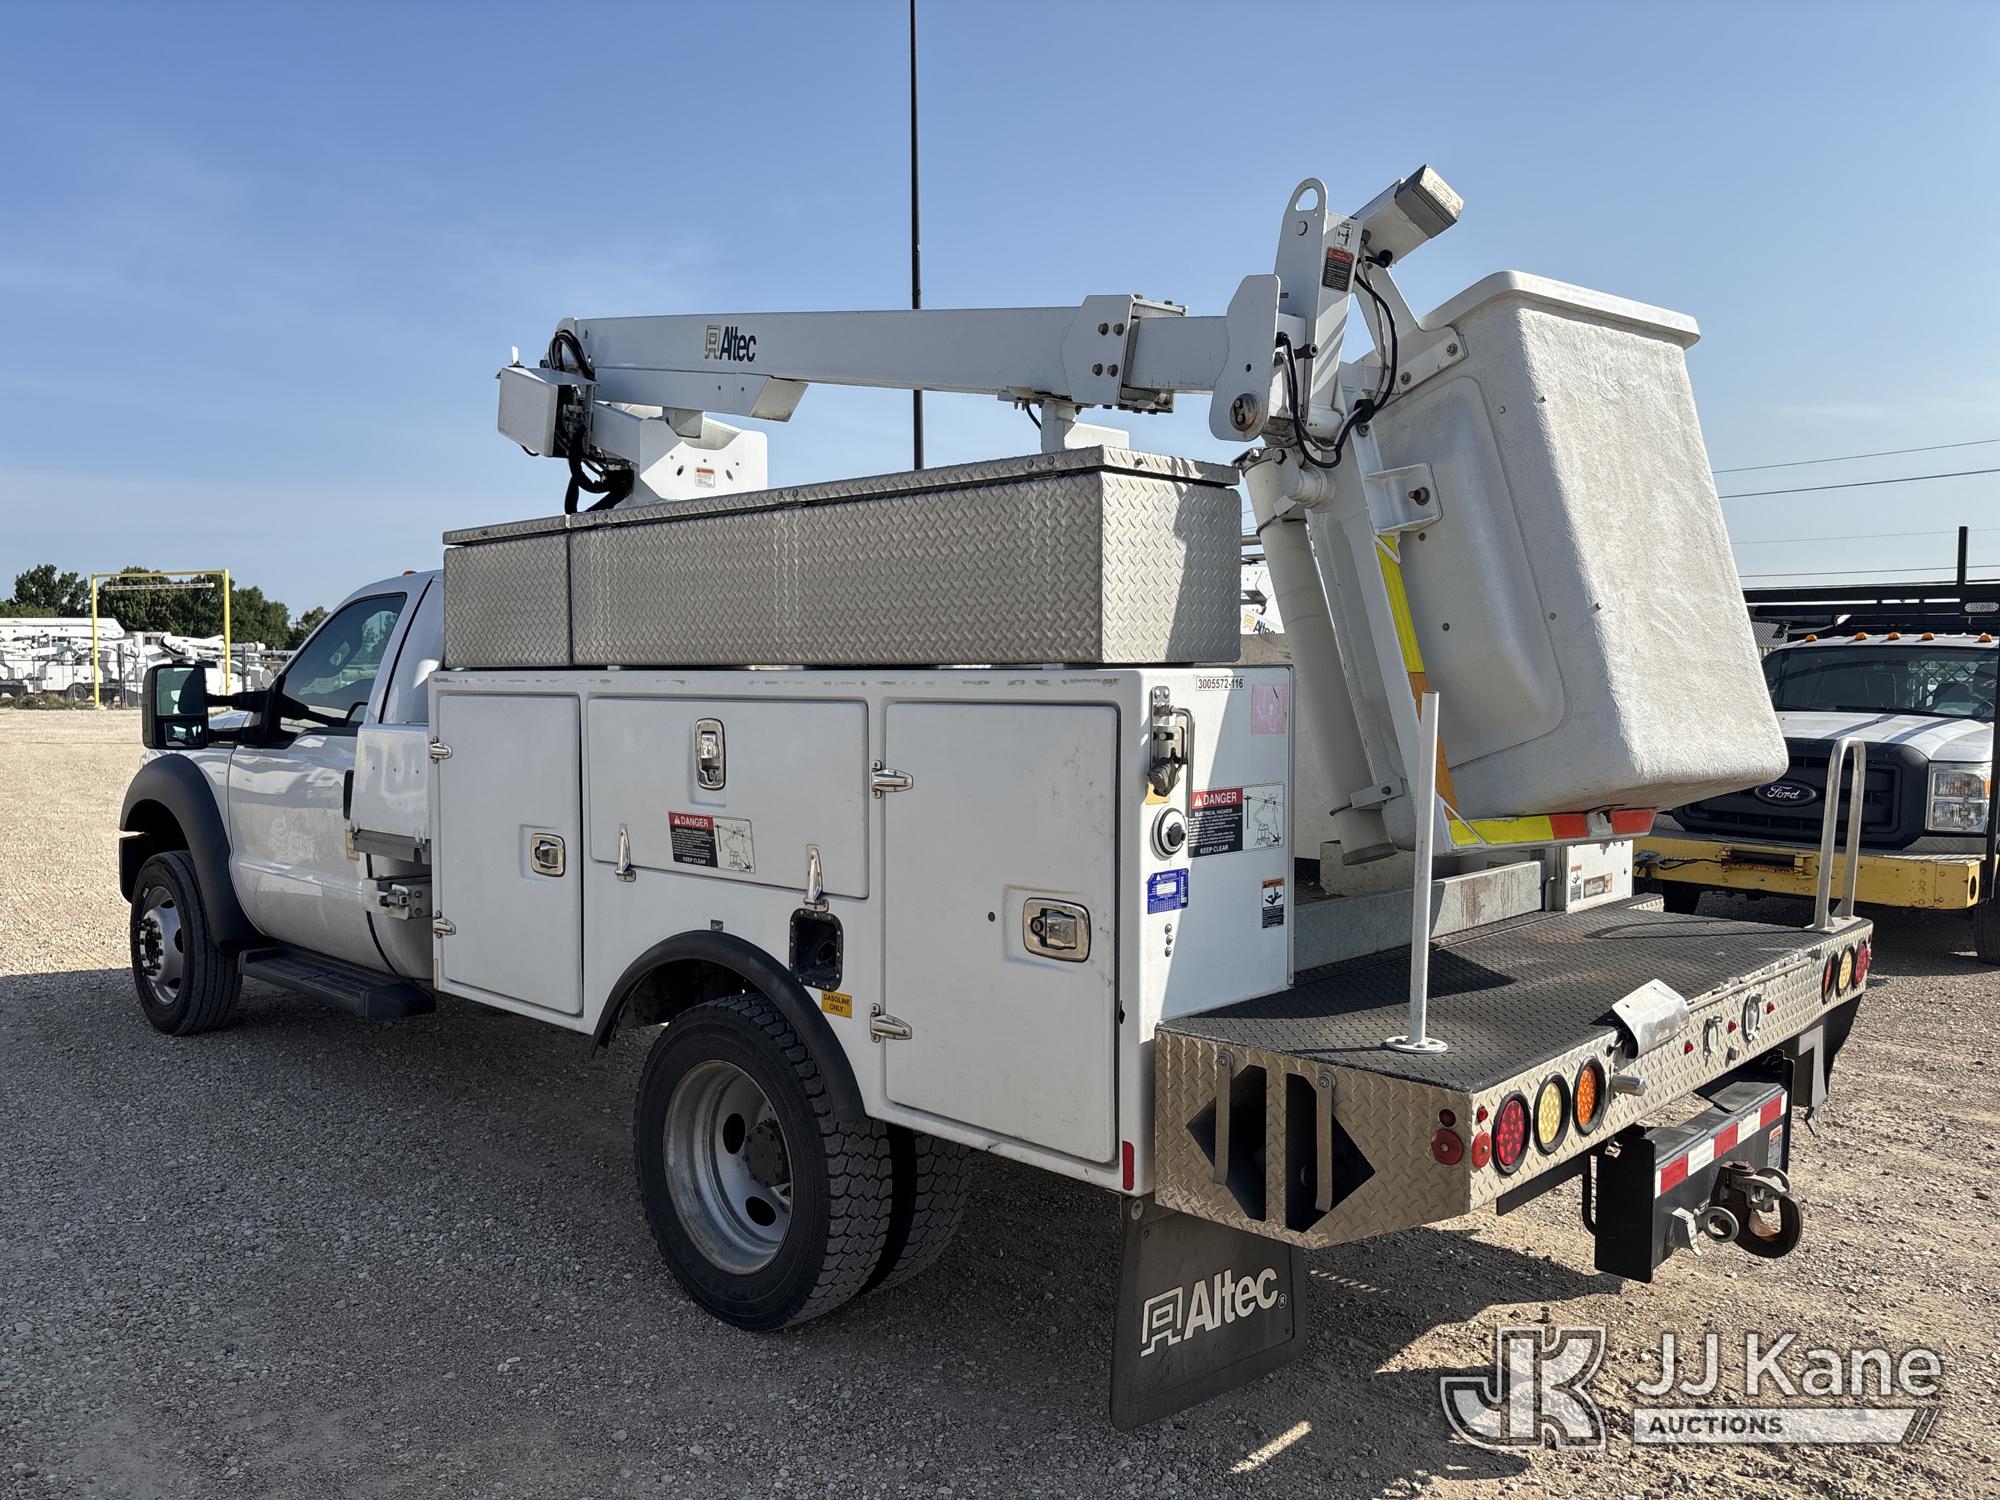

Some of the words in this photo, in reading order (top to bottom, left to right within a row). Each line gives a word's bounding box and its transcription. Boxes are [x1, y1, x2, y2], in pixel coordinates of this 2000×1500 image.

[719, 325, 757, 363] Altec
[1198, 678, 1244, 689] 3005572-116
[1203, 791, 1237, 806] DANGER
[1766, 785, 1801, 800] Ford
[680, 816, 709, 828] DANGER
[1200, 846, 1213, 854] KEEP
[1213, 844, 1229, 852] CLEAR
[823, 993, 851, 1006] GASOLINE
[829, 1003, 844, 1013] ONLY
[1183, 1267, 1279, 1341] Altec
